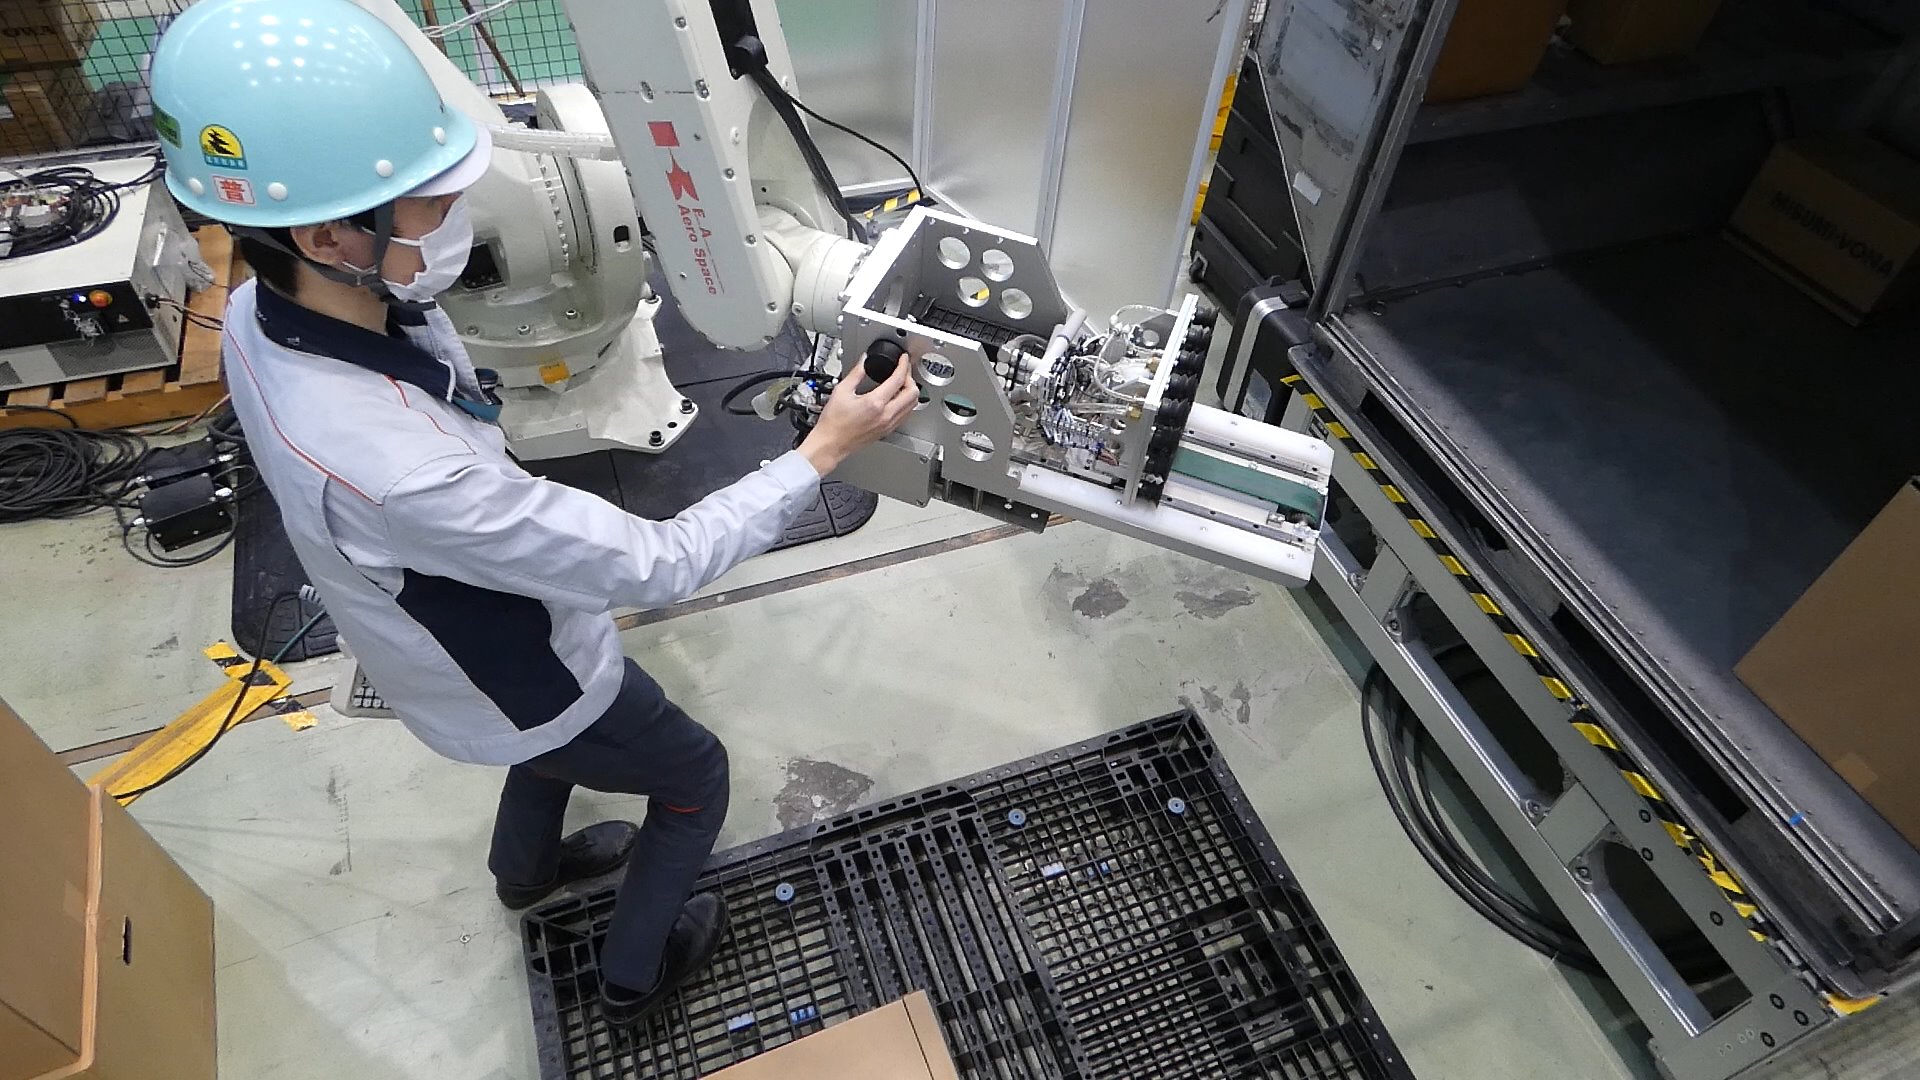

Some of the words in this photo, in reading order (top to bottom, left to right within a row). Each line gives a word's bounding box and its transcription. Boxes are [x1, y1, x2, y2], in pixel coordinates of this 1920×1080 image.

[219, 180, 245, 202] 普
[678, 204, 698, 242] Aero
[694, 247, 716, 295] Space
